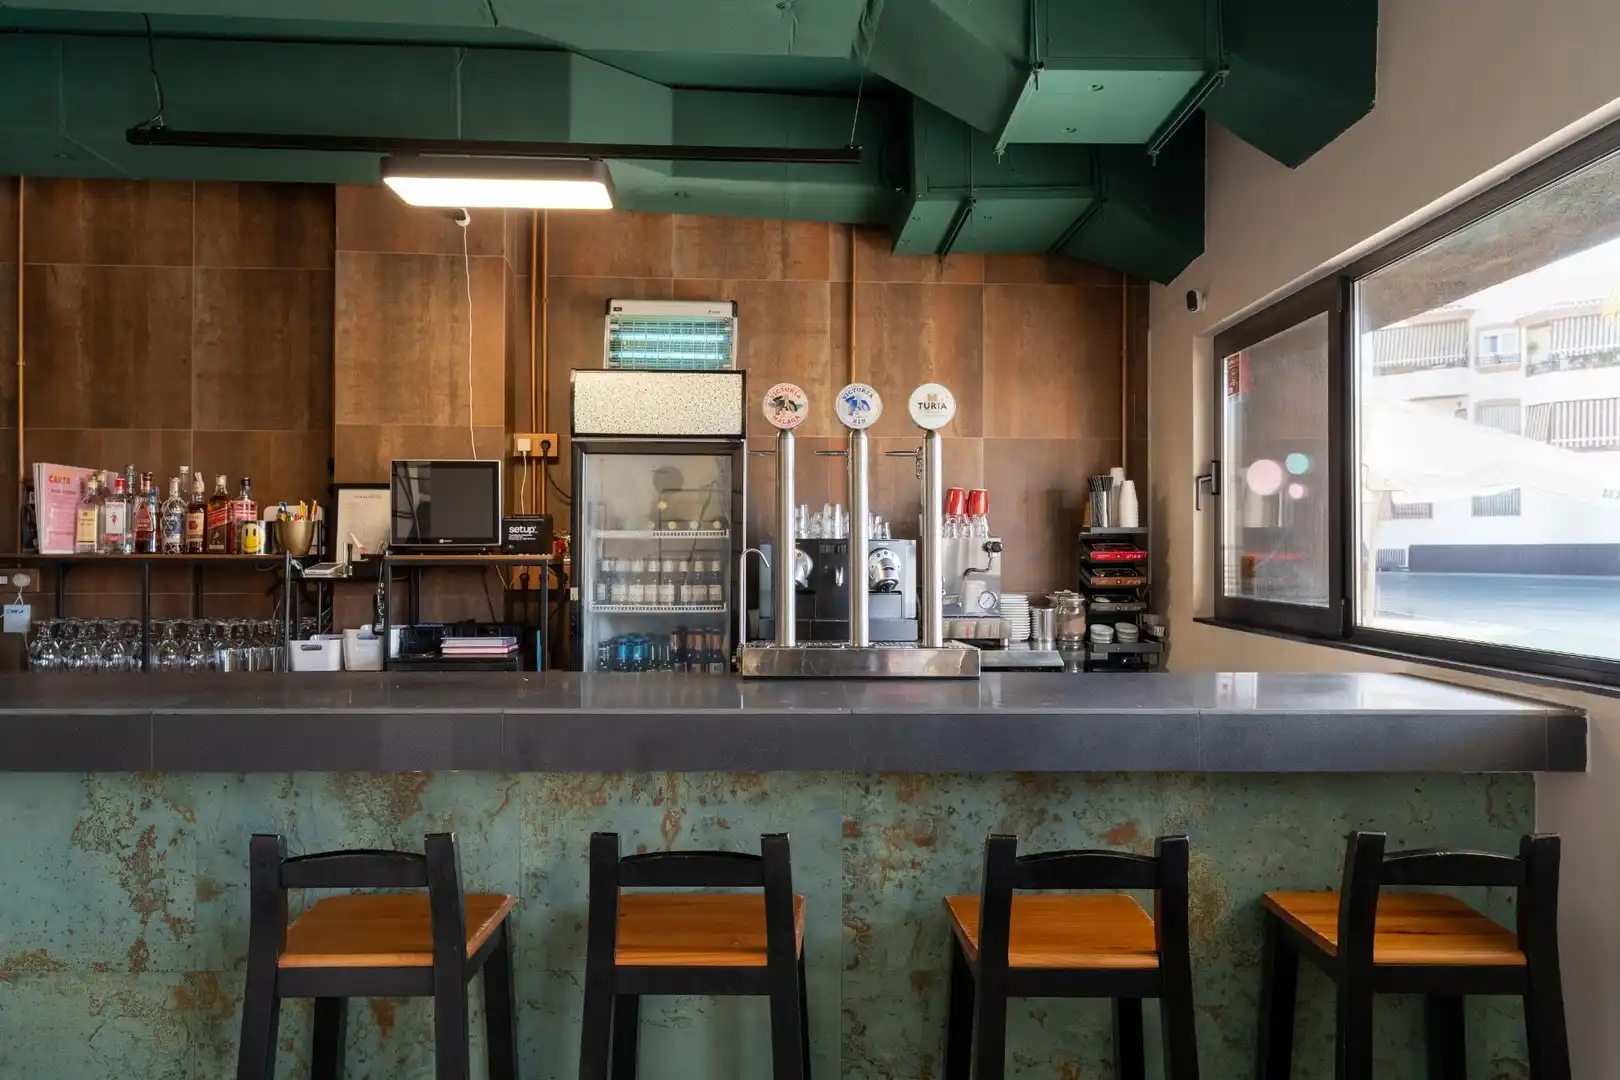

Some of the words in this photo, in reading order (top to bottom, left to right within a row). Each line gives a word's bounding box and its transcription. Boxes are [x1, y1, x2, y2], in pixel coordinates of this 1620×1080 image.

[769, 387, 801, 400] VICTORIA
[841, 386, 874, 400] VICTORIA
[917, 402, 947, 410] TURIA
[508, 526, 536, 535] setup
